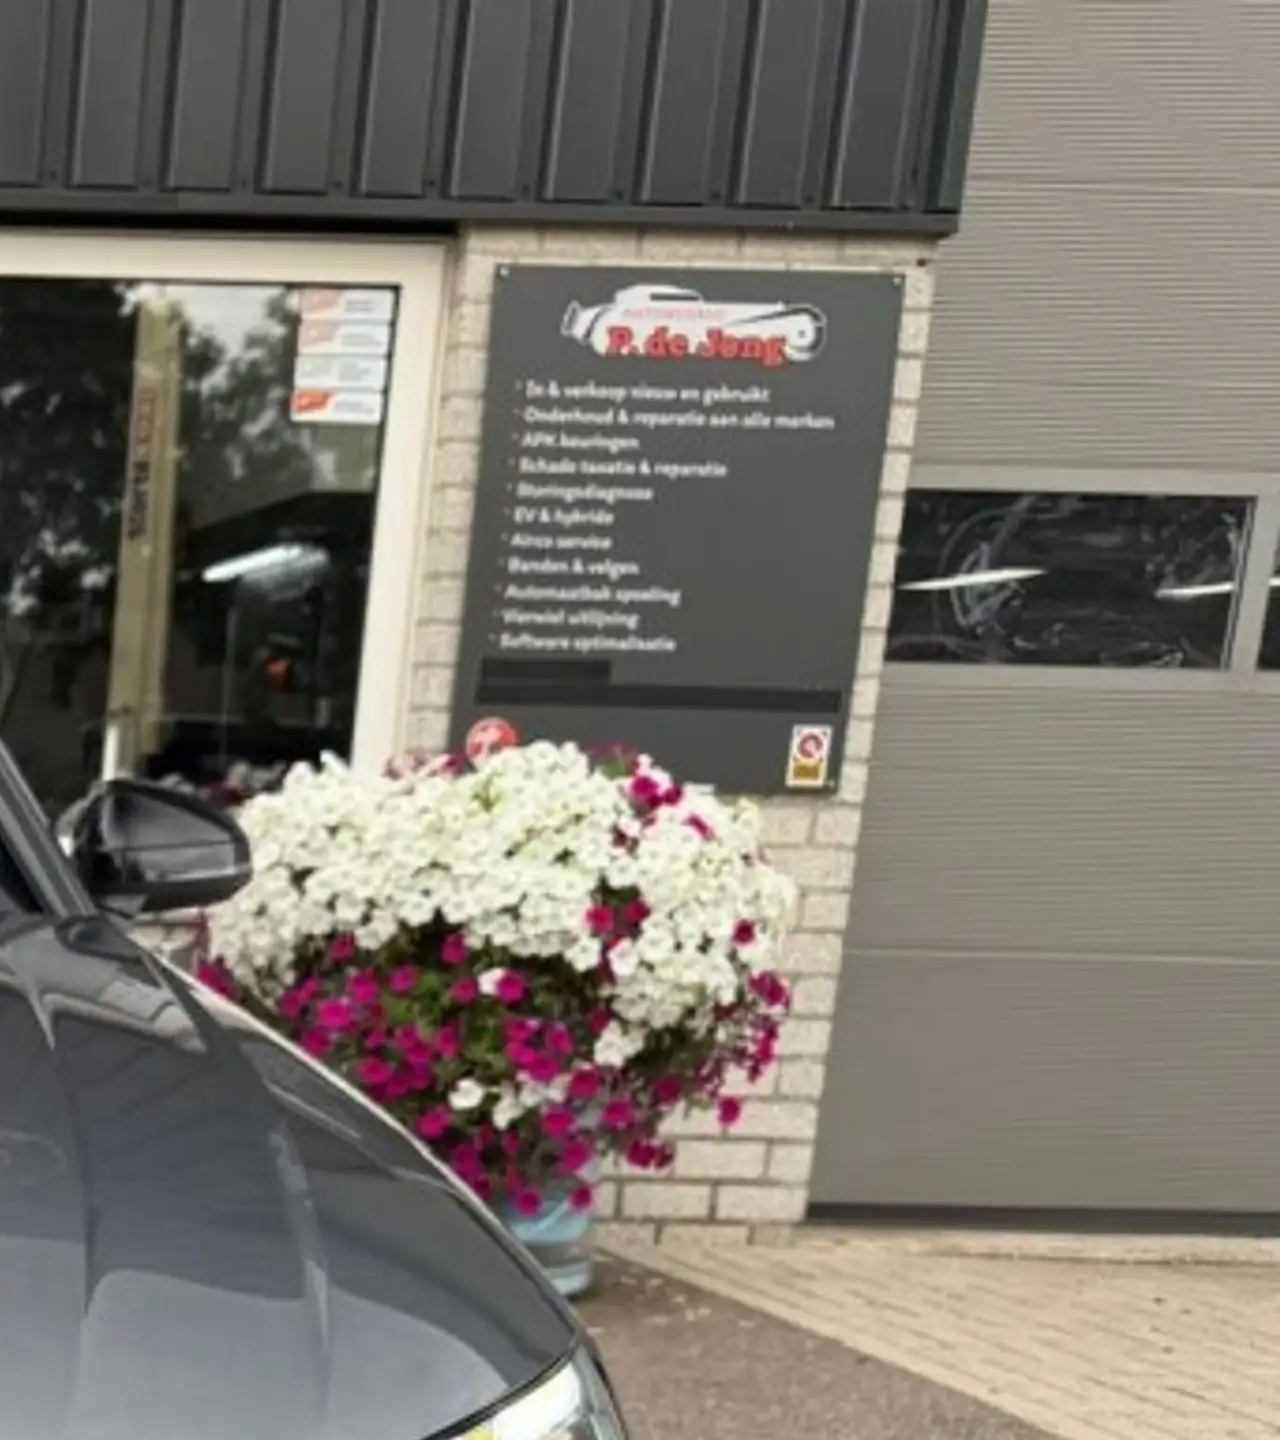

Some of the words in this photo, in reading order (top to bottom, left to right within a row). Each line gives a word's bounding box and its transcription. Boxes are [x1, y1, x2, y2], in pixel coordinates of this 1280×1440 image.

[604, 325, 638, 357] P.
[643, 326, 690, 358] de
[694, 327, 787, 367] Jong
[548, 380, 560, 399] &
[564, 381, 627, 403] verkoop
[631, 382, 678, 400] nieuw
[680, 387, 700, 401] en
[703, 383, 772, 407] gebruikt
[523, 405, 614, 425] Onderhoud
[617, 408, 630, 424] &
[633, 409, 706, 429] reparatie
[709, 414, 738, 427] aan
[743, 411, 771, 428] alle
[519, 456, 577, 475] Schade
[580, 458, 636, 476] taxatie
[639, 458, 651, 475] &
[654, 460, 728, 480] reparatie
[513, 506, 537, 524] EV
[539, 507, 551, 524] &
[554, 507, 615, 529] hybride
[510, 531, 554, 550] Airco
[556, 533, 614, 550] service
[506, 555, 569, 575] Banden
[572, 557, 585, 575] &
[587, 557, 640, 582] velgen
[615, 585, 683, 608] spoeling
[499, 633, 570, 650] Software
[573, 634, 678, 655] optimalisatie
